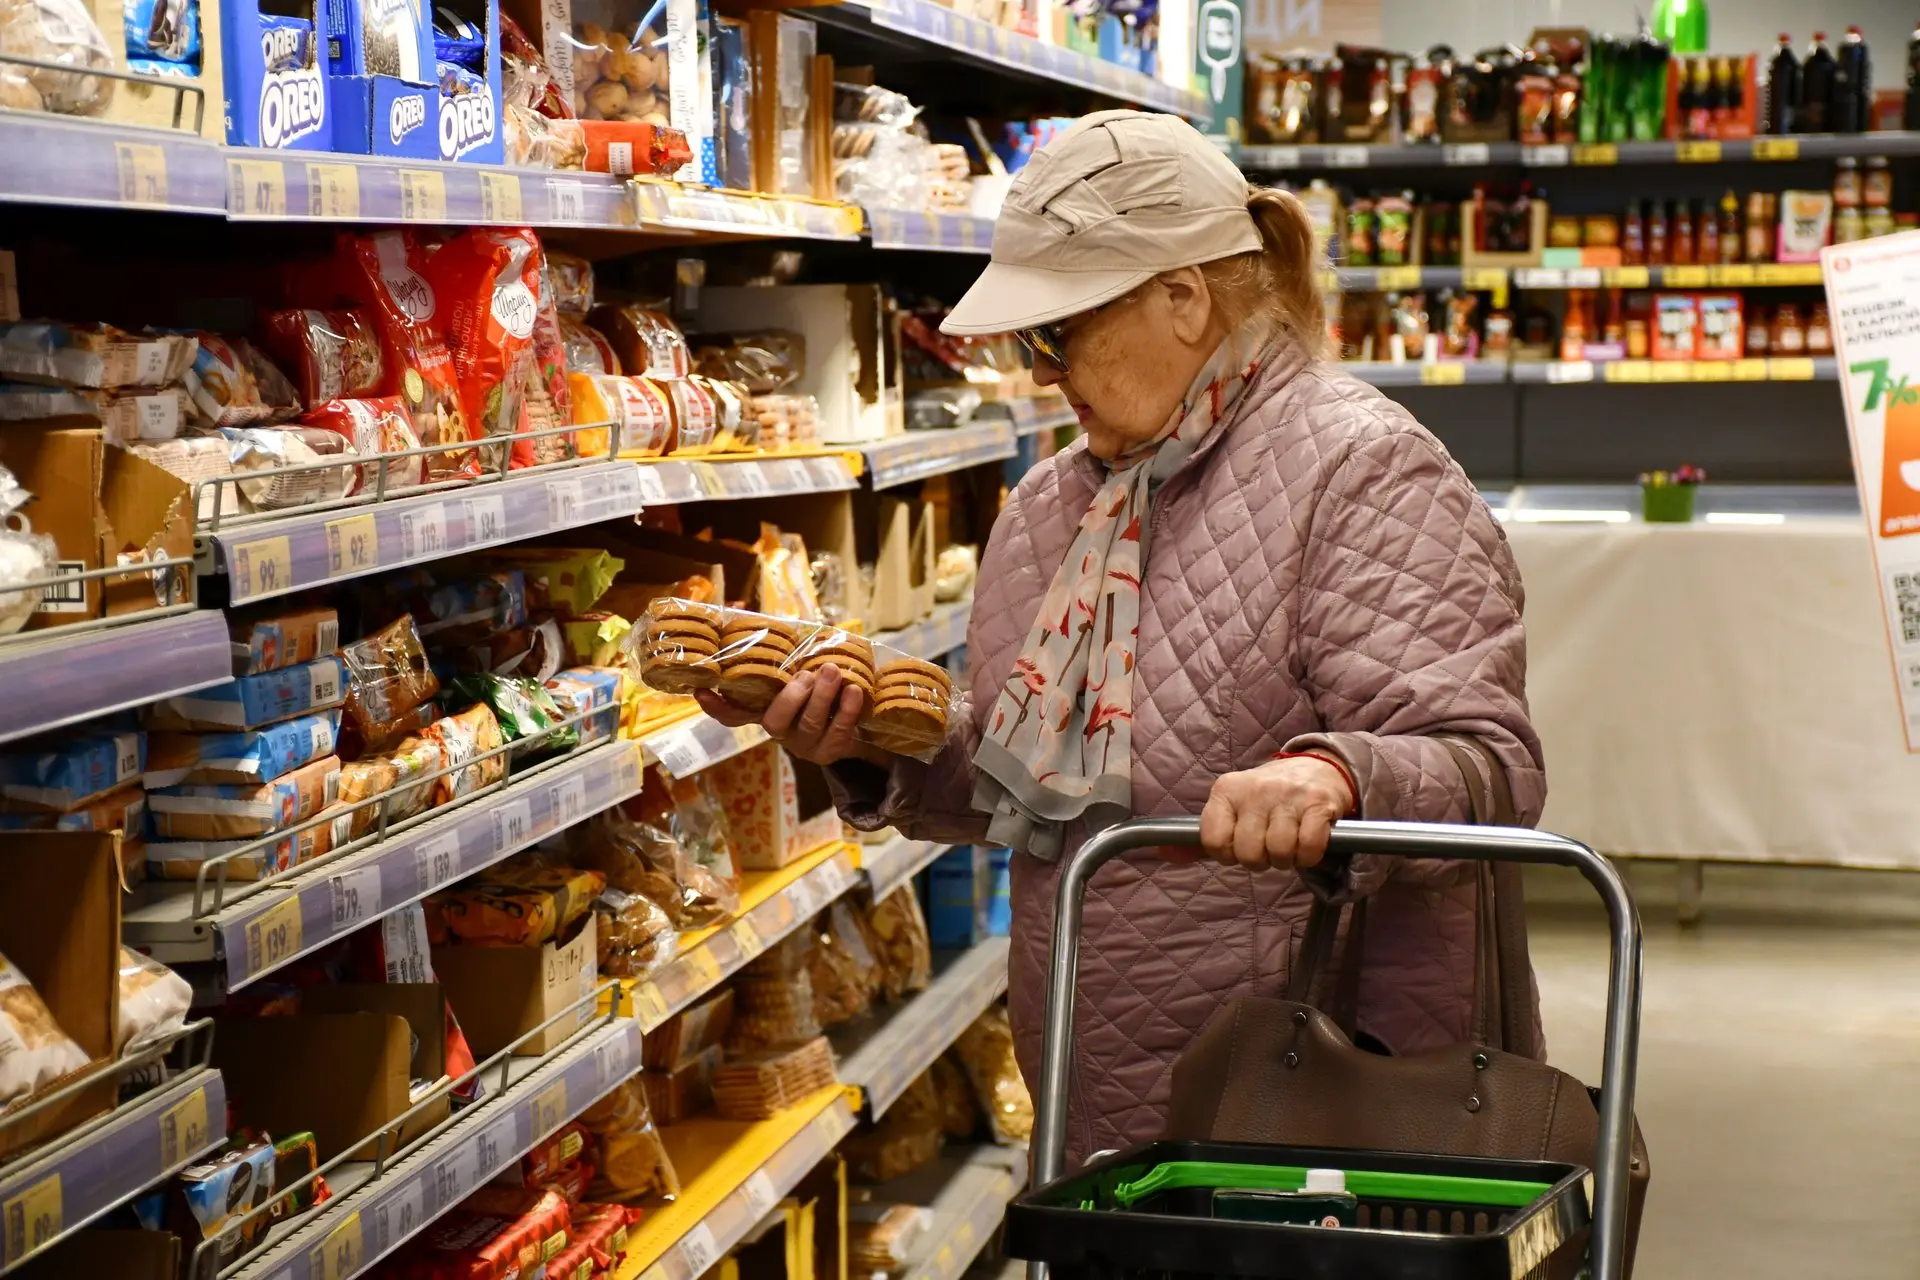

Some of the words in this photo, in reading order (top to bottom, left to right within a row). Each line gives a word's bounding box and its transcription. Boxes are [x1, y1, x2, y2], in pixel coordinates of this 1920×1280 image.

[262, 29, 298, 65] OREO
[261, 77, 323, 148] OREO
[391, 95, 424, 142] OREO
[439, 95, 494, 162] OREO
[457, 308, 473, 379] ЯБЛОЧНЫМ
[1849, 358, 1918, 412] 7%
[343, 887, 358, 926] 79
[266, 923, 287, 964] 139
